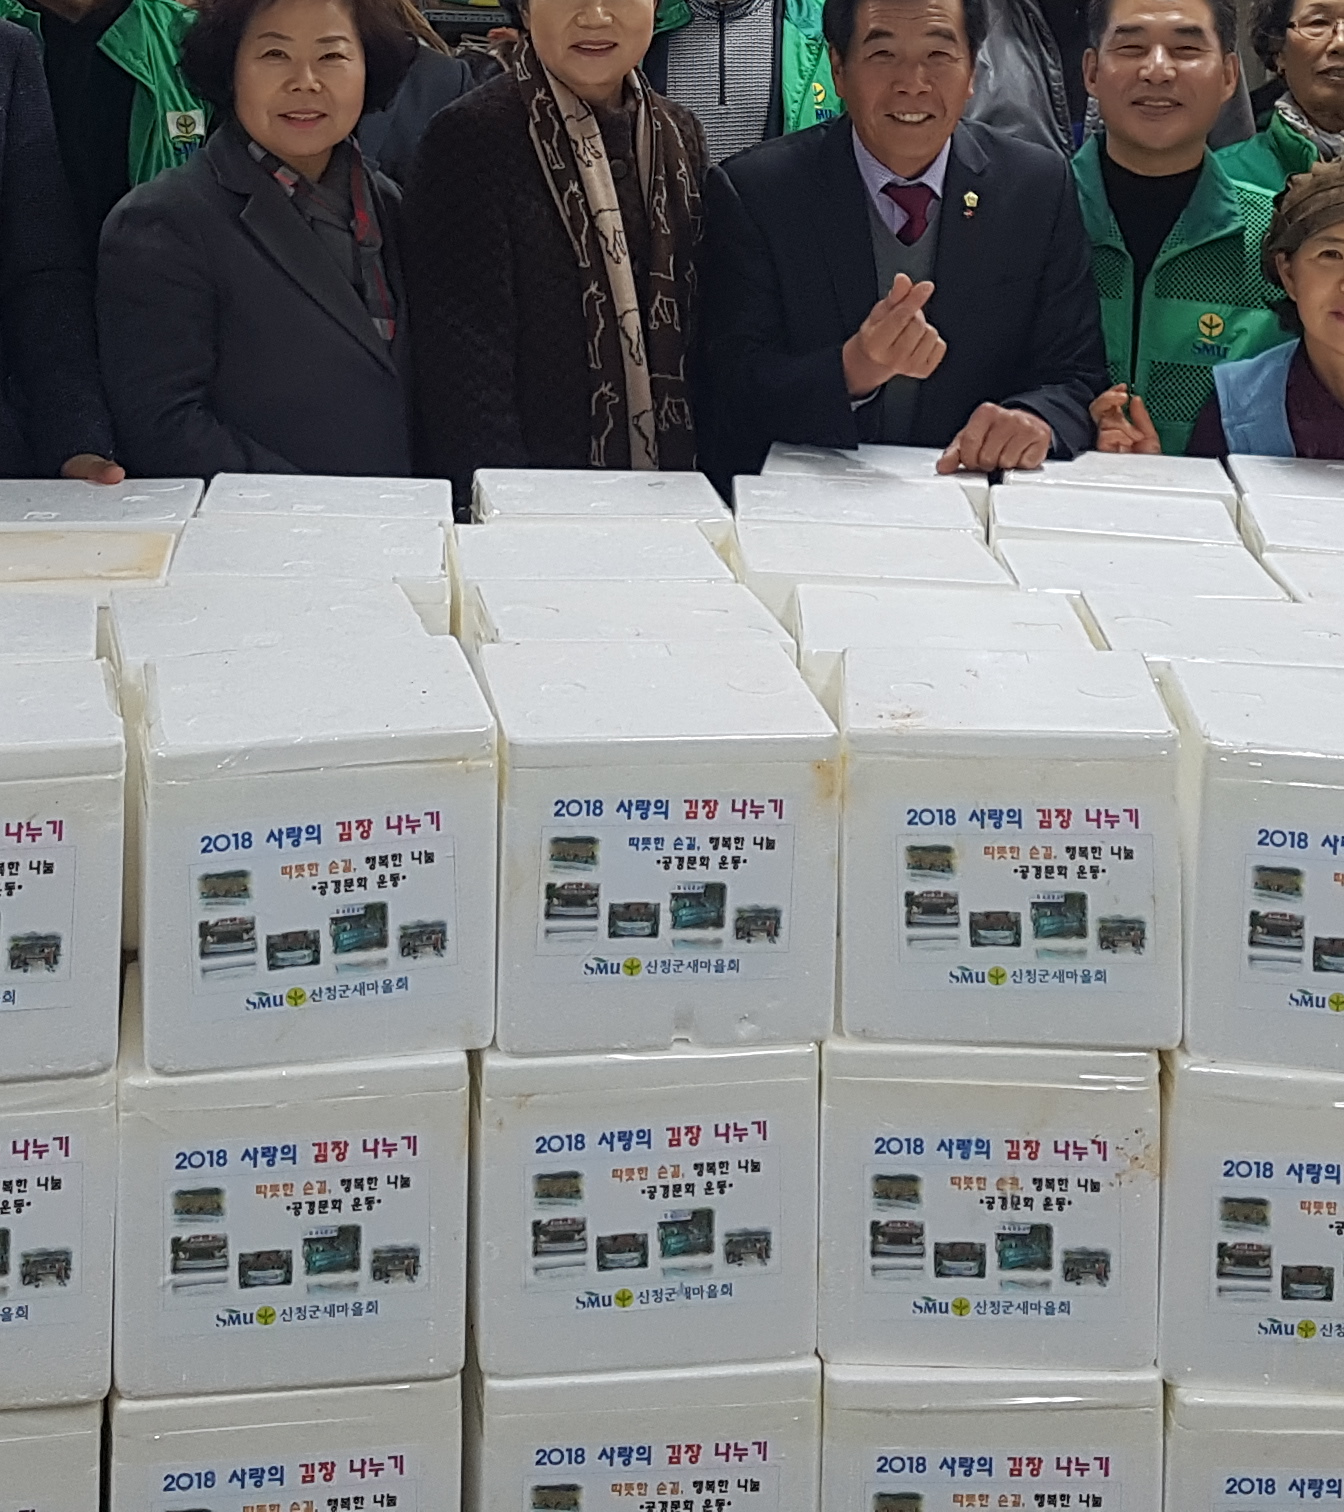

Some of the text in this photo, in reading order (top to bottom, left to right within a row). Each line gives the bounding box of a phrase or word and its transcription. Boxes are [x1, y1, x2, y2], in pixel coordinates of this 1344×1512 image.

[1191, 342, 1229, 359] SMU
[552, 799, 785, 821] 2018 사랑의 김장 나누기
[906, 808, 1139, 830] 2018 사랑의 김장 나누기
[3, 820, 64, 845] 나누기
[199, 811, 441, 855] 2018 사랑의 김장 나누기
[1256, 828, 1309, 850] 2018
[984, 846, 1020, 860] 따뜻한
[1065, 845, 1102, 860] 행복한
[1110, 845, 1134, 860] 나눔
[583, 958, 740, 976] SMU 산청군새마을회
[948, 968, 1107, 985] SMU 산청군새마을회
[245, 976, 408, 1012] SMU 산청군새마을회
[1288, 990, 1327, 1010] SMU
[534, 1120, 768, 1155] 2018 사랑의 김장 나누기
[11, 1137, 70, 1163] 나누기
[174, 1135, 418, 1170] 2018 사랑의 김장 나누기
[873, 1137, 1107, 1162] 2018 사랑의 김장 나누기
[1221, 1160, 1274, 1179] 2018
[1285, 1162, 1342, 1185] 사랑의
[534, 1441, 769, 1468] 2018 사랑의 김장 나누기
[163, 1455, 406, 1493] 2018 사랑의 김장 나누기
[876, 1456, 1110, 1478] 2018 사랑의 김장 나누기
[1225, 1478, 1276, 1495] 2018
[1287, 1478, 1342, 1499] 사랑의
